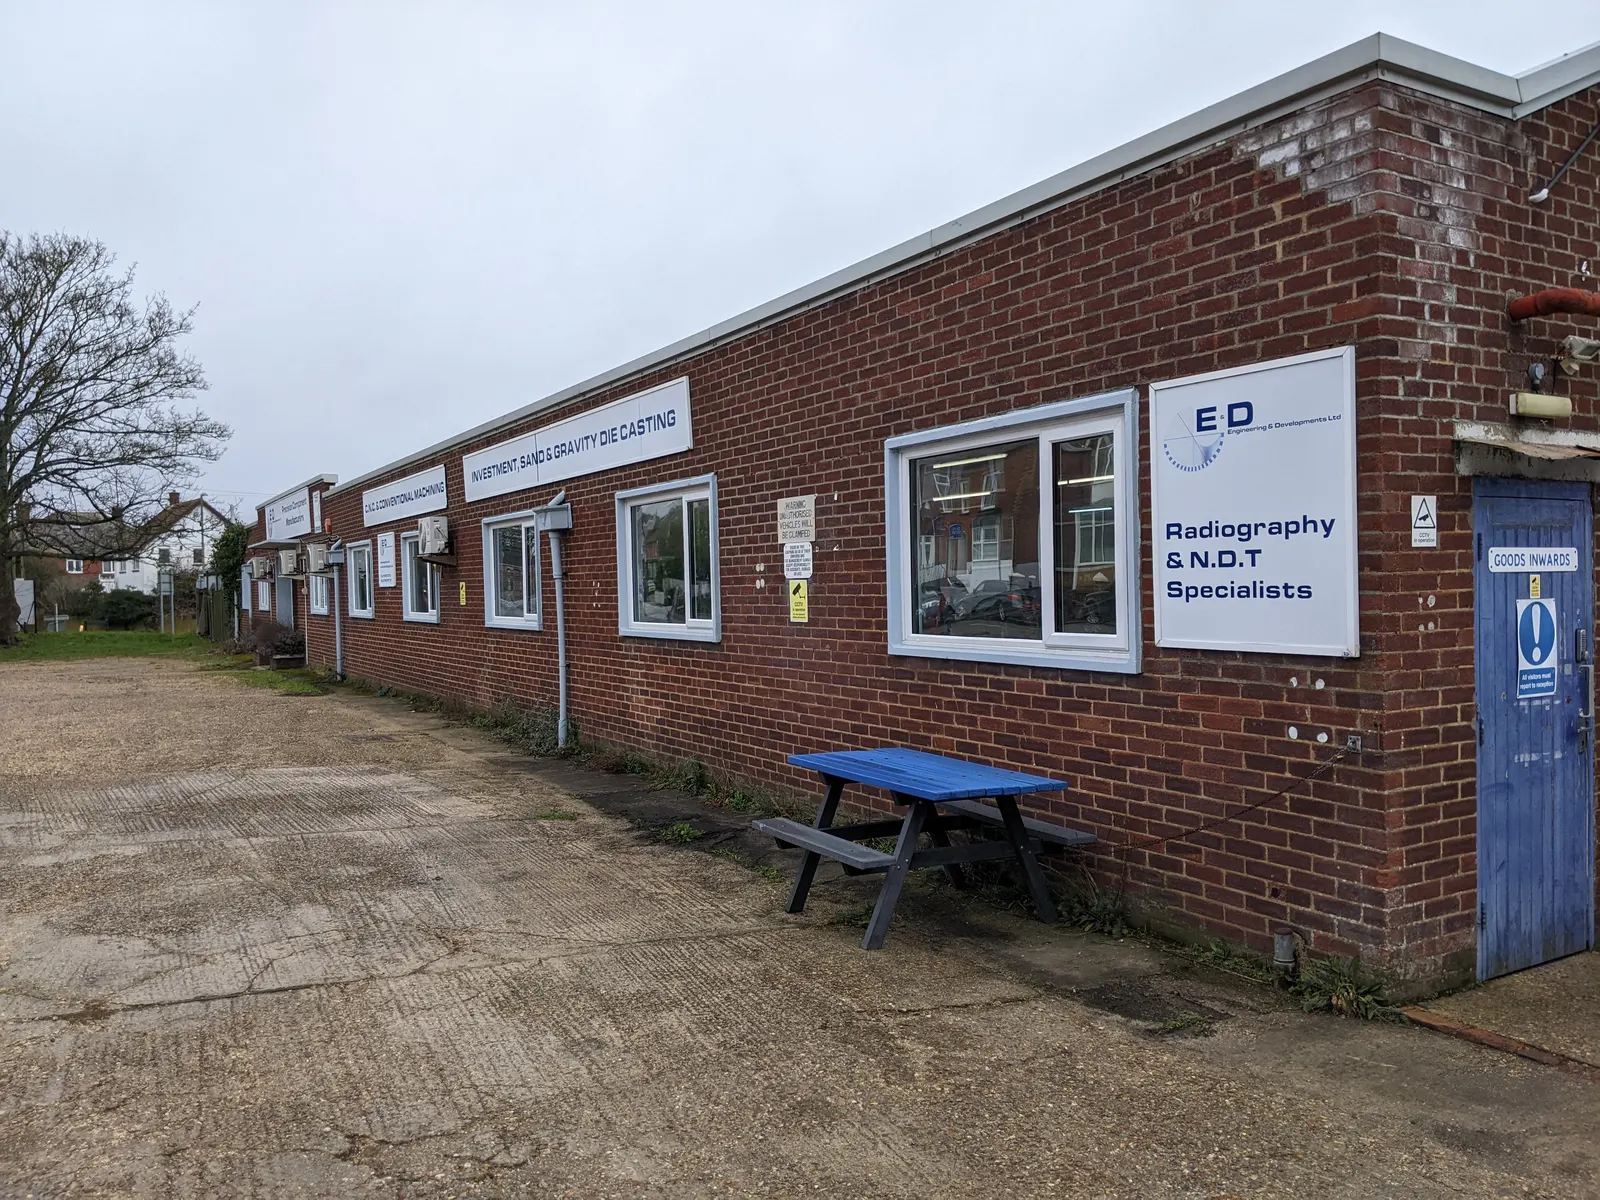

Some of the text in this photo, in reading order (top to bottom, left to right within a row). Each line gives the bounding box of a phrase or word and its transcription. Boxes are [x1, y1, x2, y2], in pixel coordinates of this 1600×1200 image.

[1227, 424, 1267, 435] Engineering
[1274, 416, 1327, 429] Developments
[472, 409, 676, 483] INVESTMENT, SAND & GRAVITY DIE CASTING
[380, 490, 414, 509] CONVENTIONAL
[414, 481, 444, 499] MACHINING
[782, 530, 810, 539] BE CLAMPED
[1166, 515, 1336, 542] Radiography
[1166, 549, 1262, 569] & N.D.T
[1494, 553, 1571, 567] GOODS INWARDS
[1167, 581, 1313, 603] Specialists
